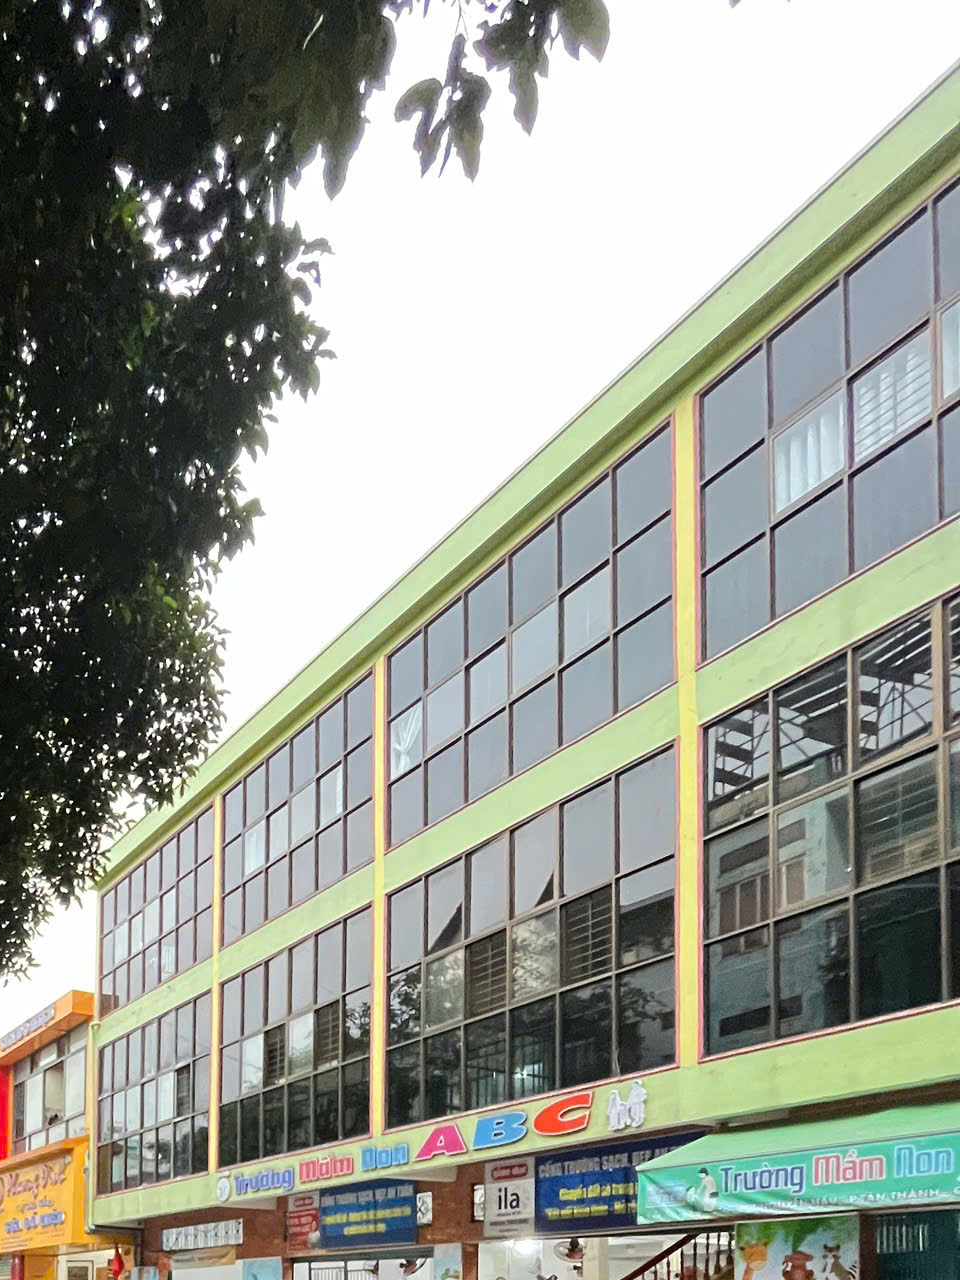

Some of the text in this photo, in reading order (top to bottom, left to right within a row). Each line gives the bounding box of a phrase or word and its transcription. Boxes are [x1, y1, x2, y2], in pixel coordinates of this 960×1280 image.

[233, 1091, 593, 1194] Trường Mầm Non ABC
[720, 1162, 805, 1195] Trường
[812, 1149, 886, 1187] Mầm
[893, 1144, 954, 1178] Non
[498, 1187, 520, 1210] ila
